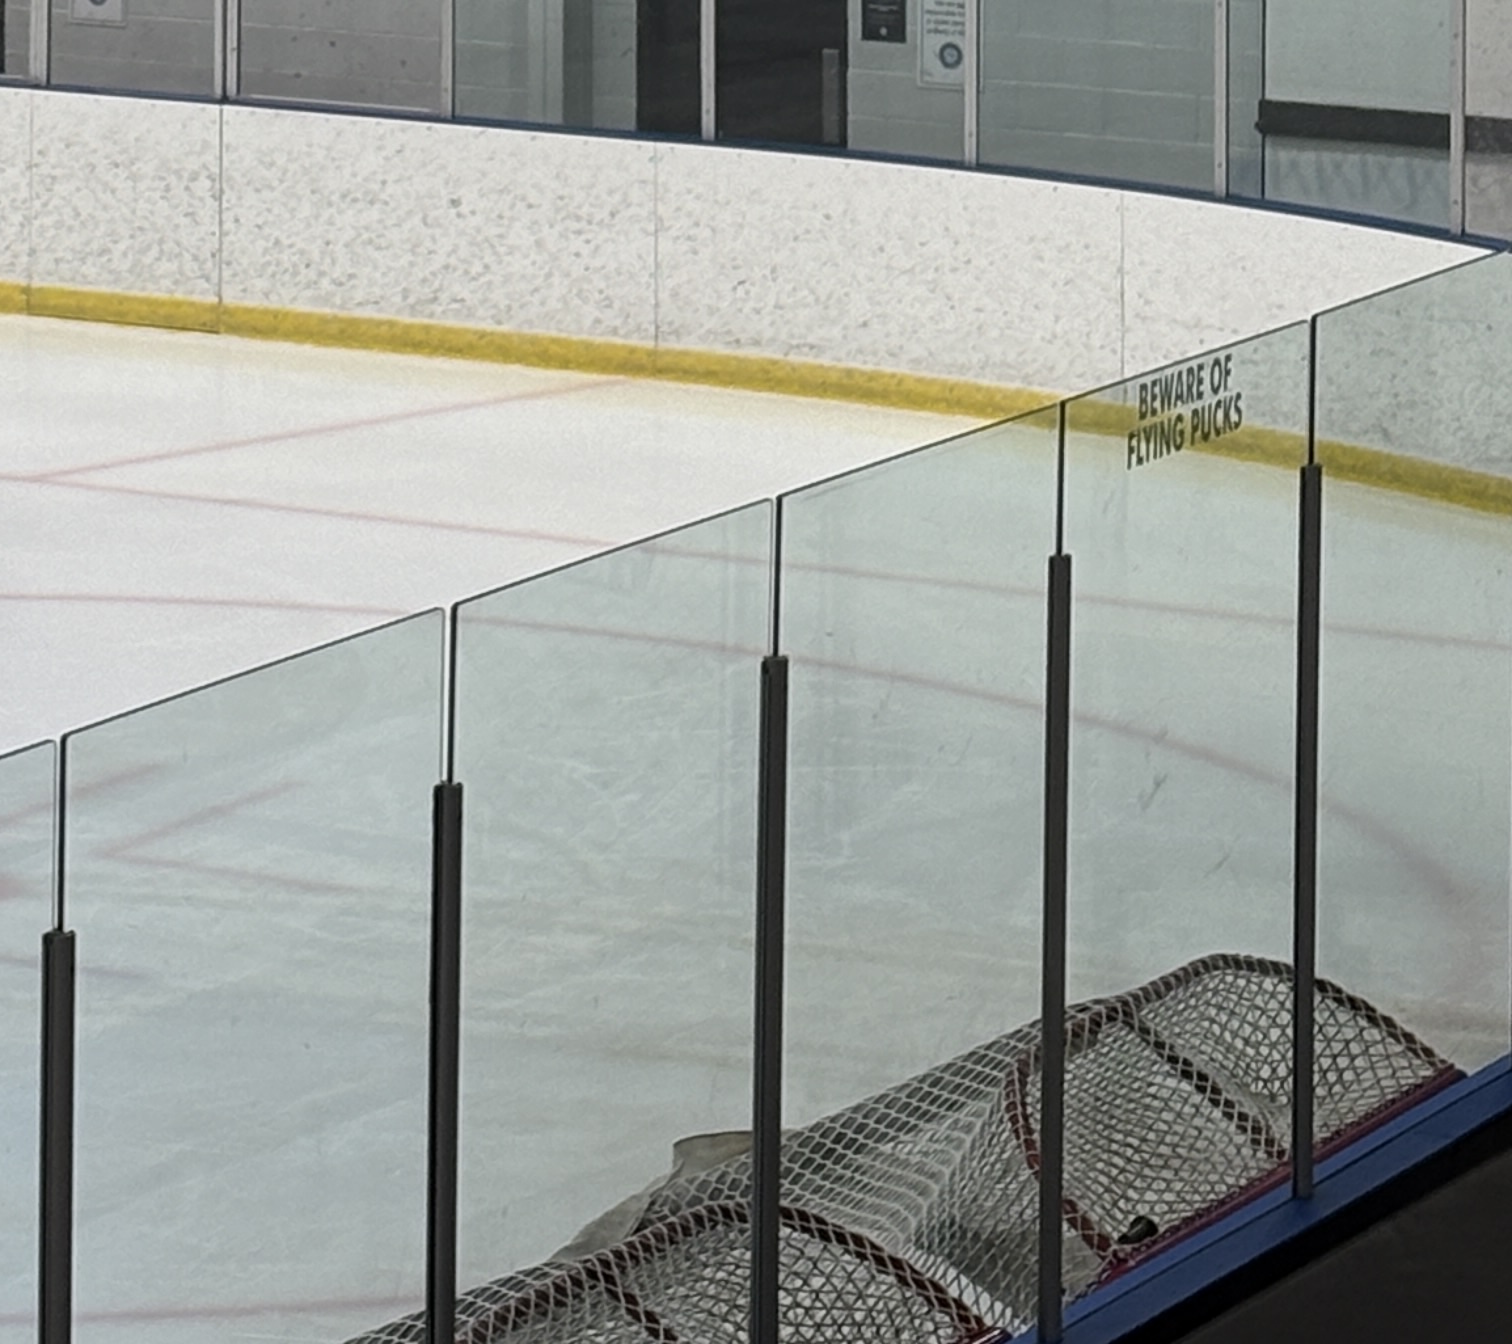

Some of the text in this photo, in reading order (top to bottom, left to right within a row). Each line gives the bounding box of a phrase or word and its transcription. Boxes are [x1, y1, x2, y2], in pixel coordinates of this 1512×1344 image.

[1139, 353, 1232, 421] BEWARE OF
[1127, 391, 1242, 470] FLYING PUCKS
